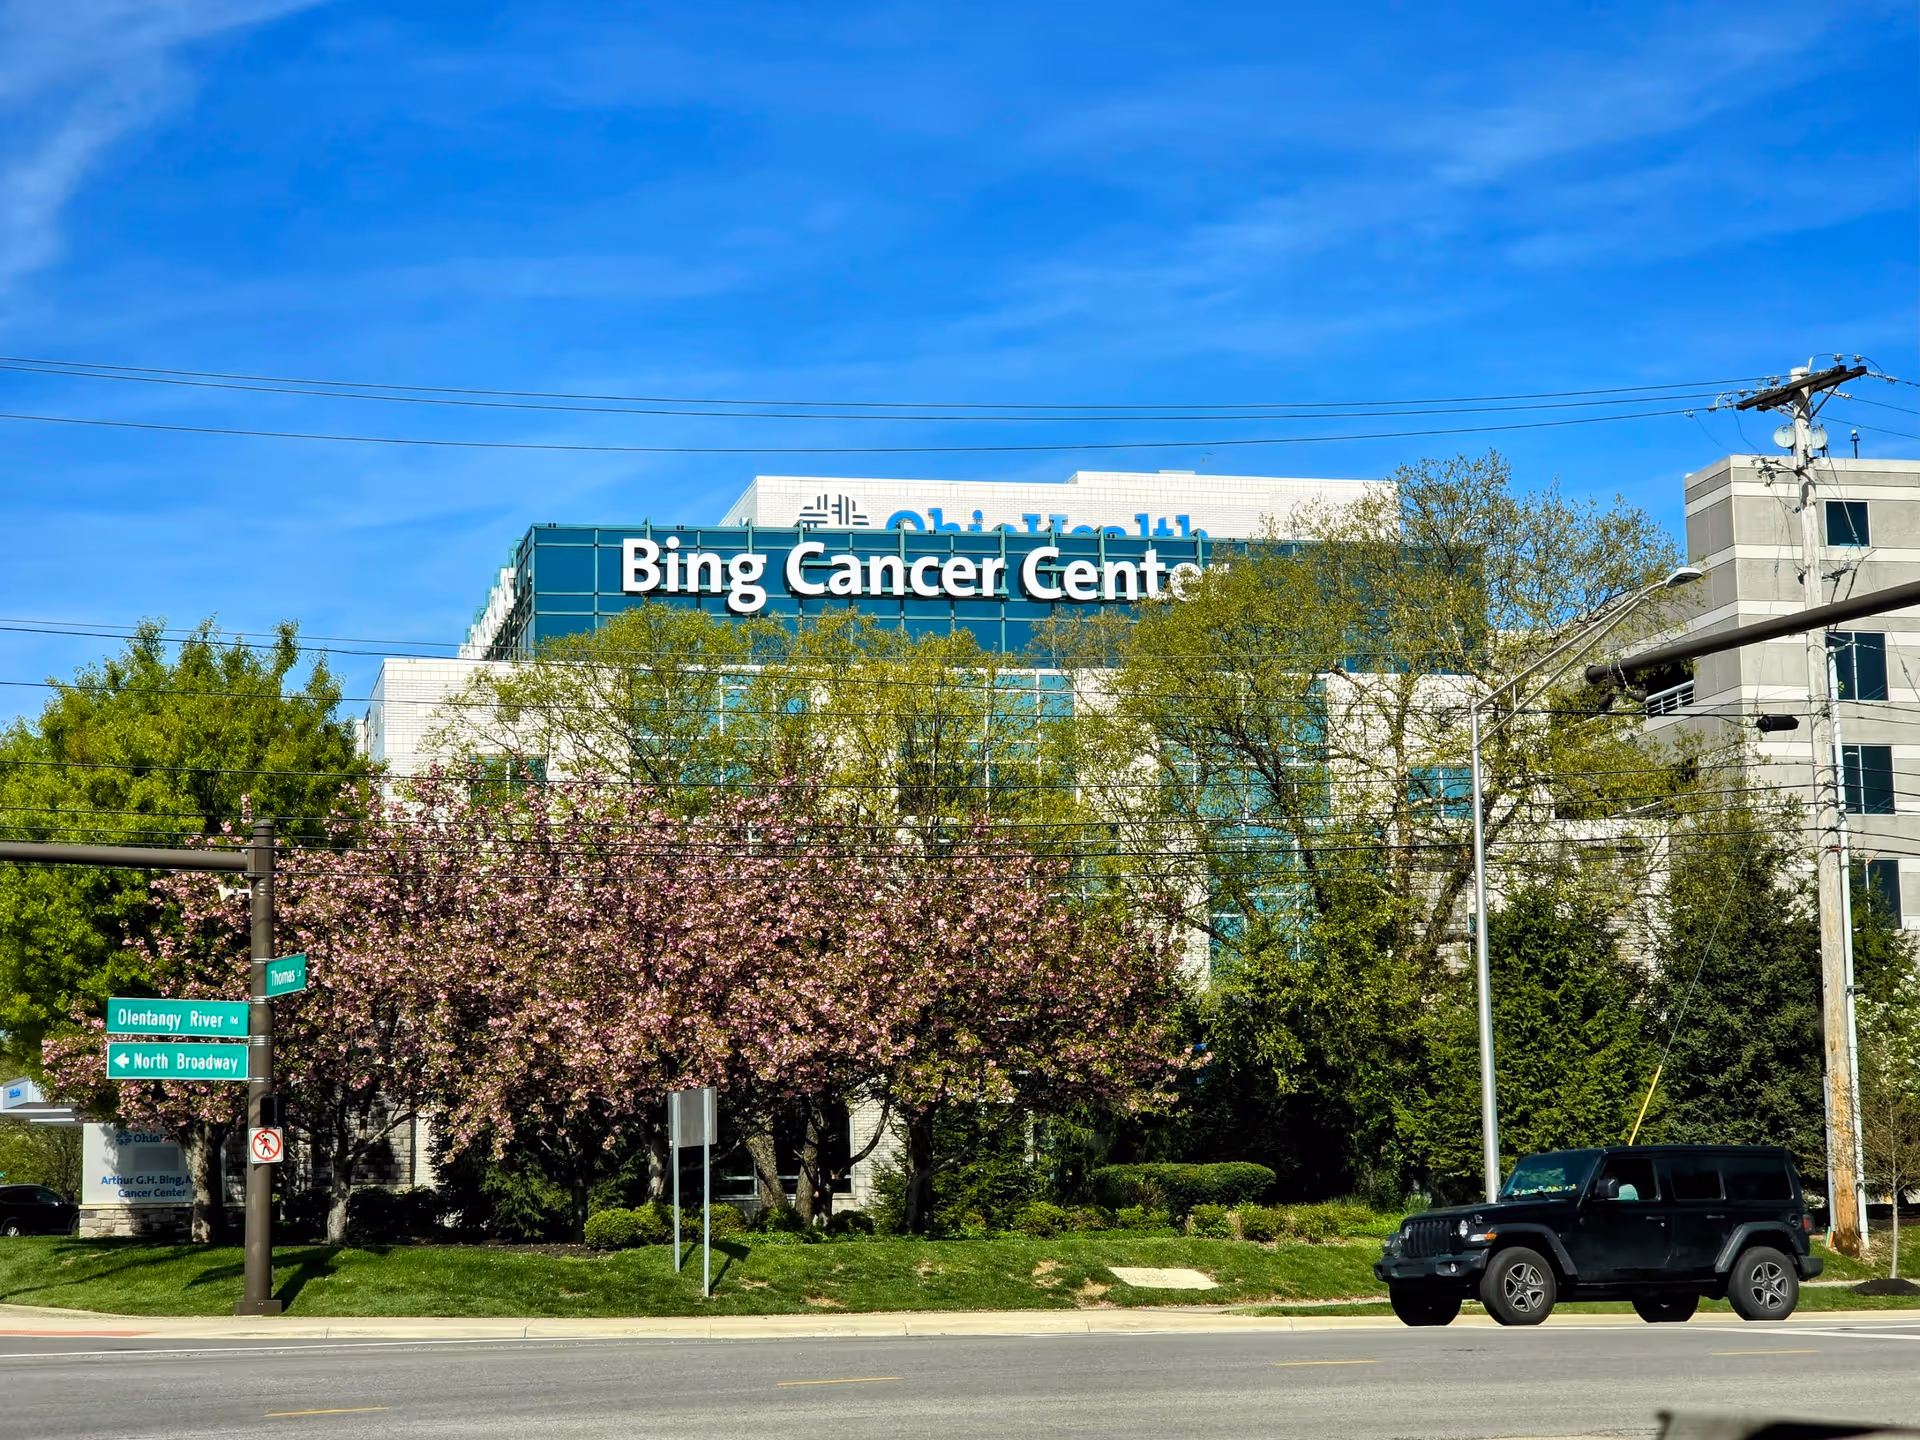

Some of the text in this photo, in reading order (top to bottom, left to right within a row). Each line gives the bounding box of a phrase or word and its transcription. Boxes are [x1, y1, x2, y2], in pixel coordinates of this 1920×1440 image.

[885, 508, 1208, 537] OhiHlth
[622, 536, 767, 613] Bing
[786, 541, 1005, 598] Cancer
[271, 969, 296, 987] Thomas
[118, 1008, 239, 1031] Olentangy River Rd
[133, 1052, 239, 1075] North Broadway
[101, 1175, 134, 1185] Arthur
[136, 1176, 157, 1185] G.H.
[160, 1175, 185, 1187] Bing,
[118, 1188, 187, 1198] Cancer Center
